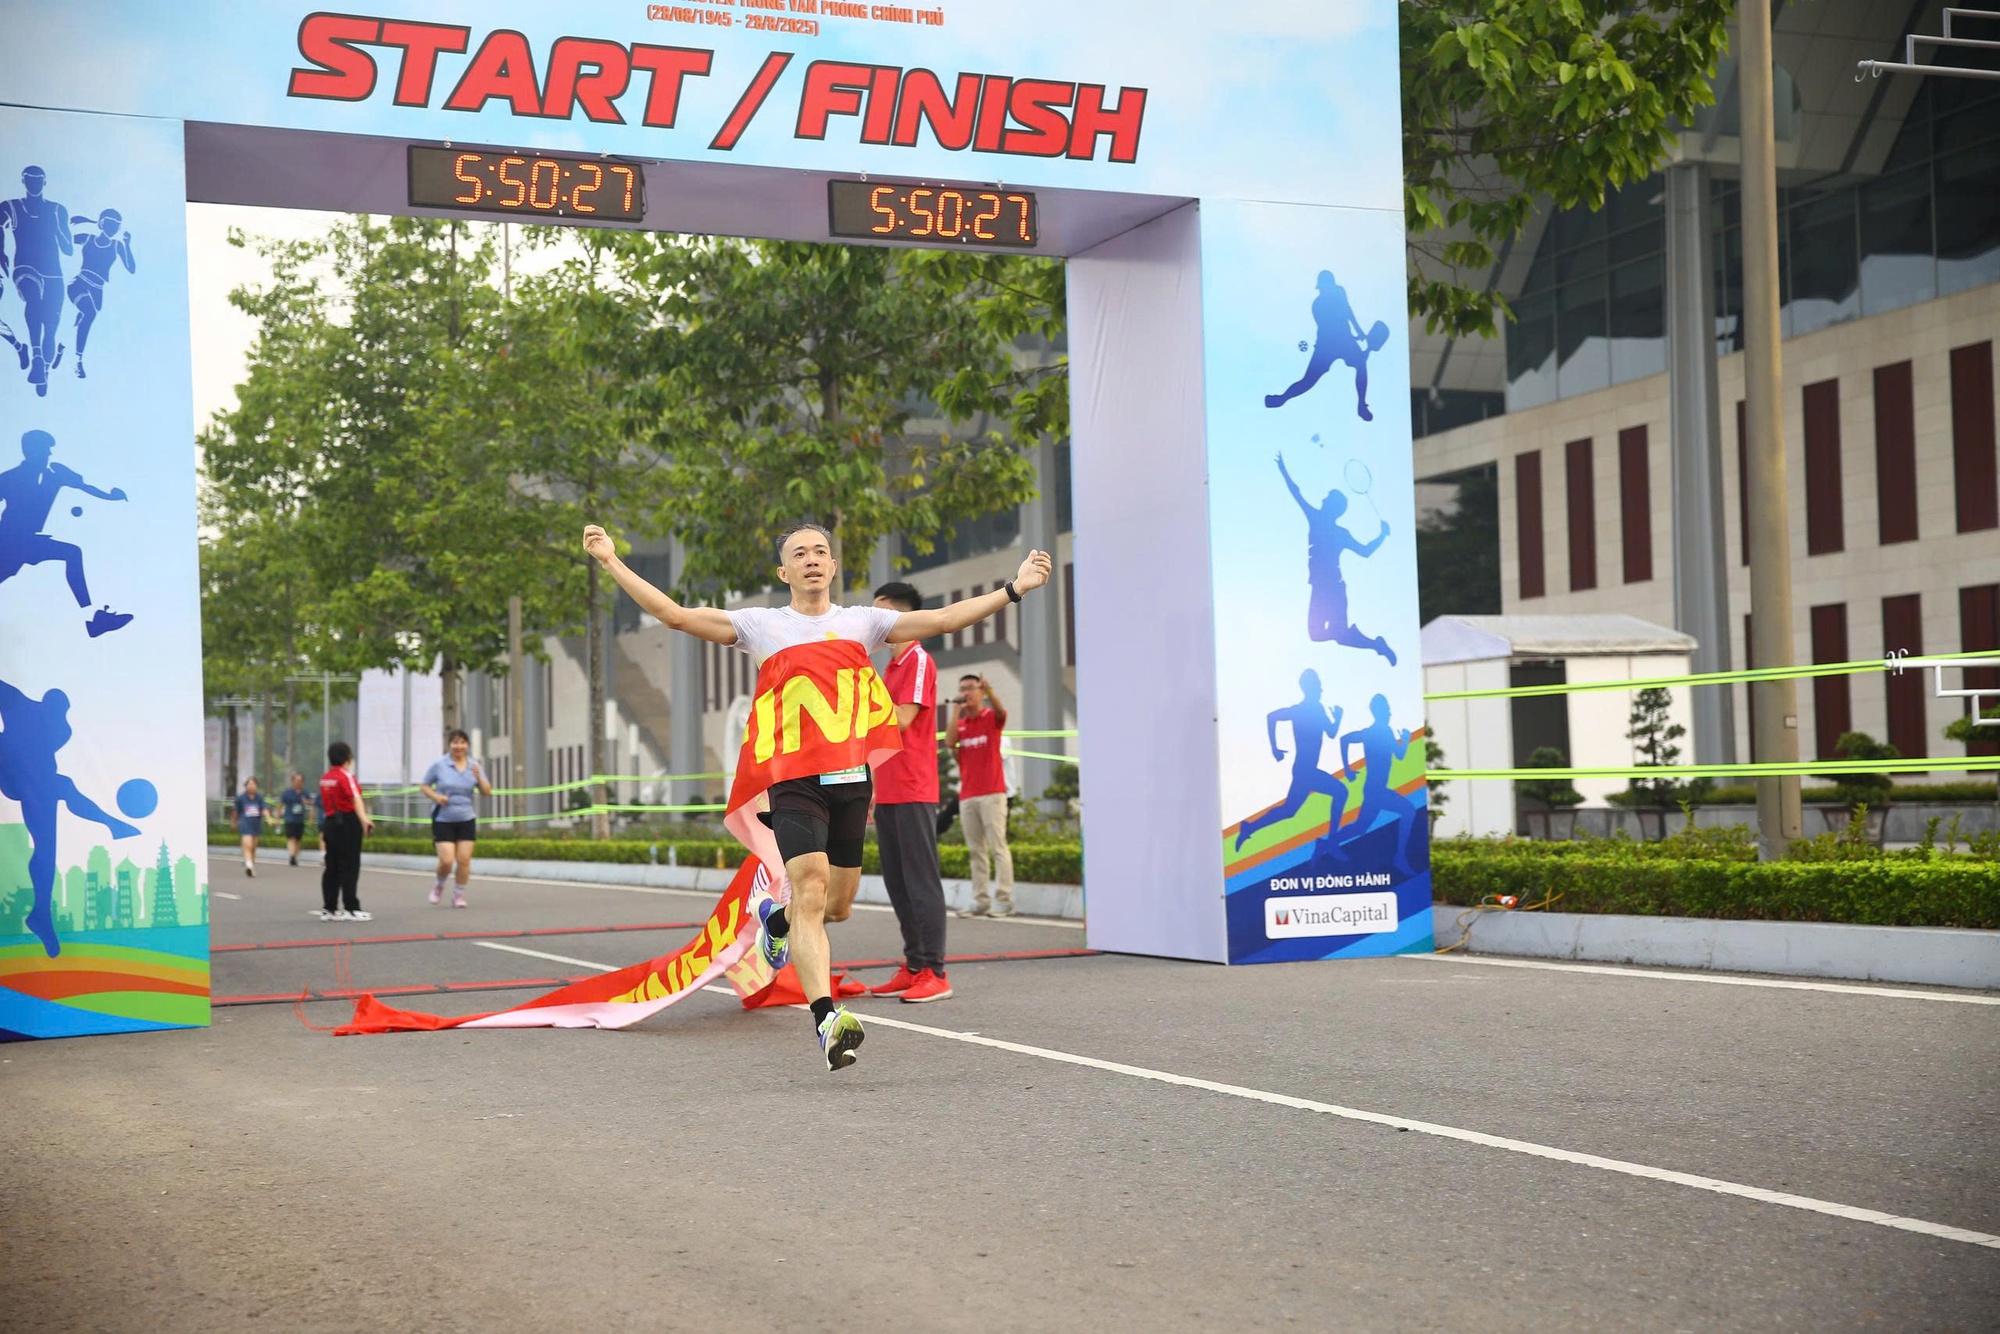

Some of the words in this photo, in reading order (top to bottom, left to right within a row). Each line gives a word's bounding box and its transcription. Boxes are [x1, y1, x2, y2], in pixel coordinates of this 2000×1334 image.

[647, 4, 733, 27] (28/08/1945
[745, 14, 819, 36] 28/8/2025)
[871, 4, 914, 24] CHÍNH
[916, 6, 945, 26] PHỦ
[287, 11, 715, 129] START
[707, 51, 795, 151] /
[794, 59, 1149, 165] FINISH
[454, 153, 635, 213] 5:50:27
[1300, 876, 1315, 892] VỊ
[1355, 871, 1391, 888] HÀNH
[1292, 903, 1389, 927] VinaCapital
